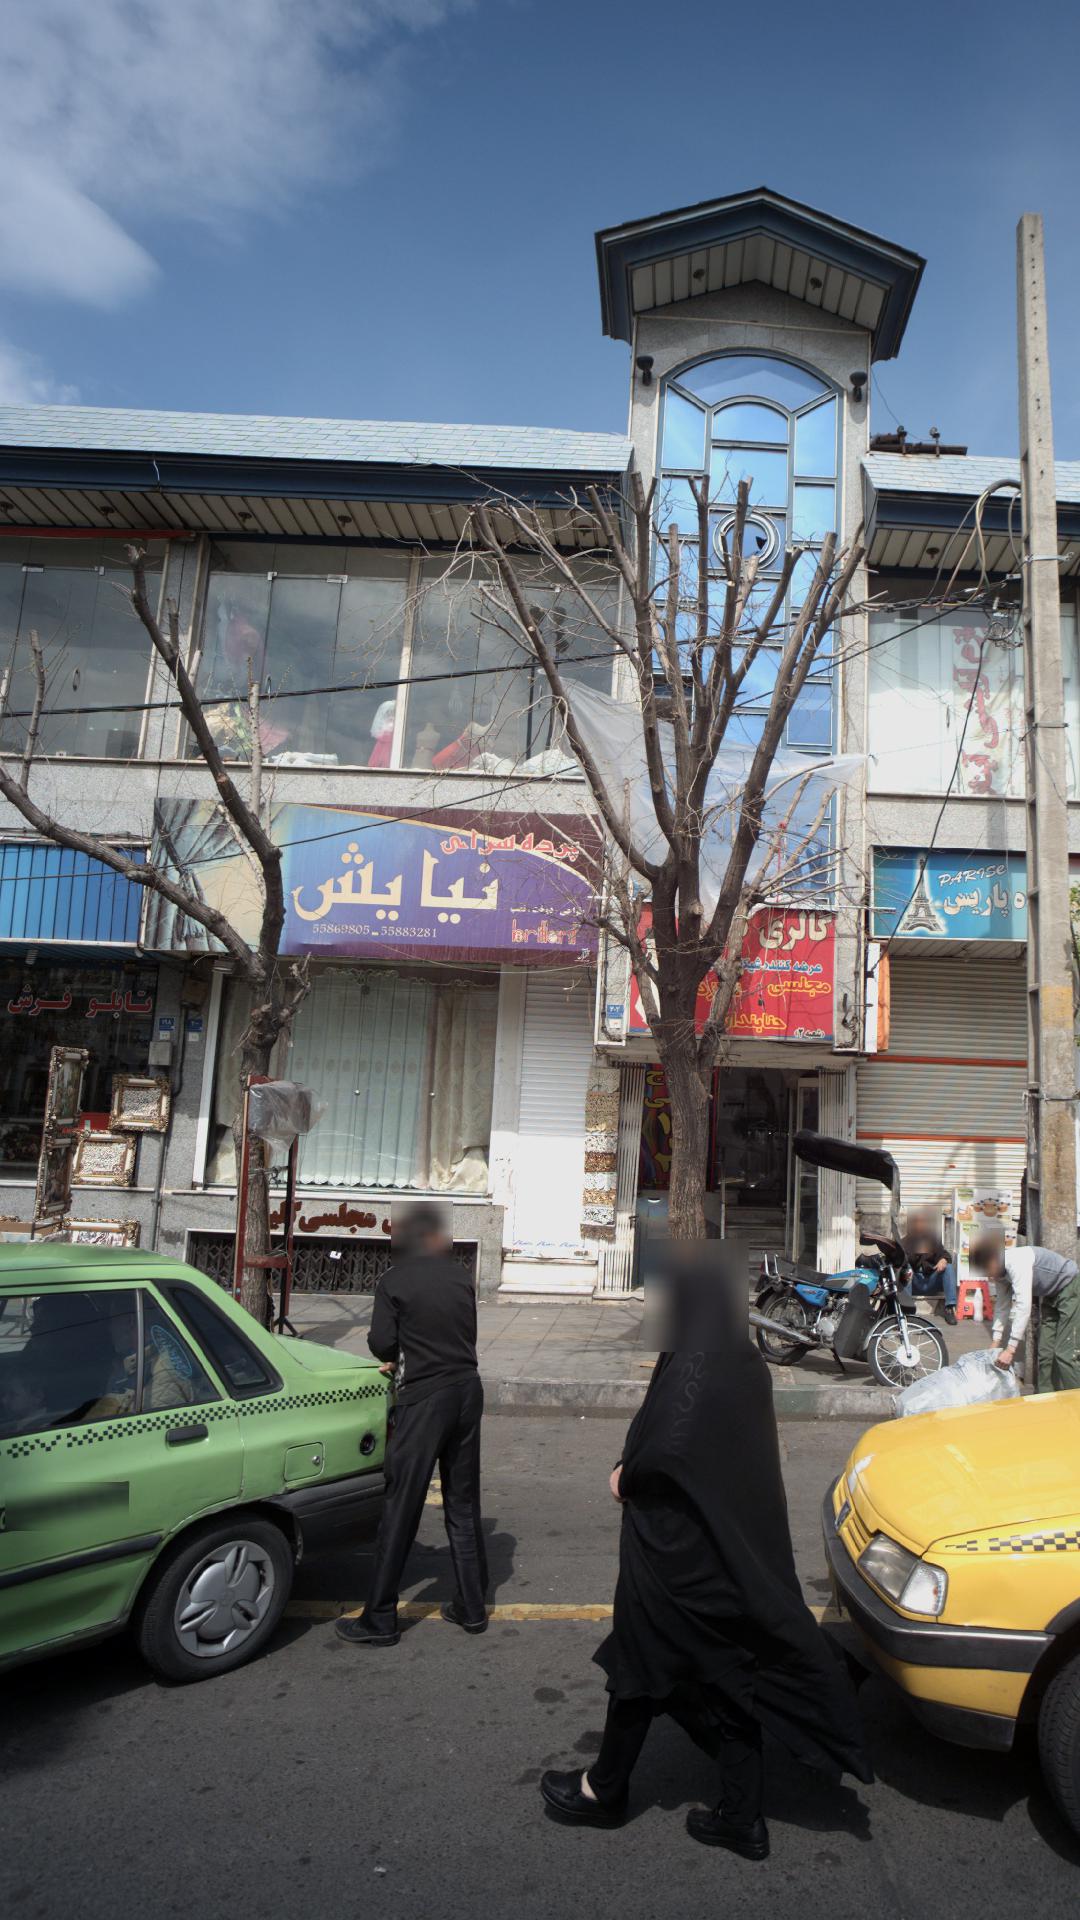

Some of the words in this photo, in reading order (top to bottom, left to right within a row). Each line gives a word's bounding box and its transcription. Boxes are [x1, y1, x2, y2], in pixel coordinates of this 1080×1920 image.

[521, 832, 580, 862] پرده
[943, 881, 1009, 918] پاریس
[381, 926, 437, 938] 55883281
[758, 911, 832, 950] گالری
[792, 960, 823, 976] عرضه
[8, 984, 72, 1017] فرش
[767, 975, 832, 998] مجلسی
[86, 990, 153, 1020] تابلو
[298, 1202, 378, 1234] مجلسی
